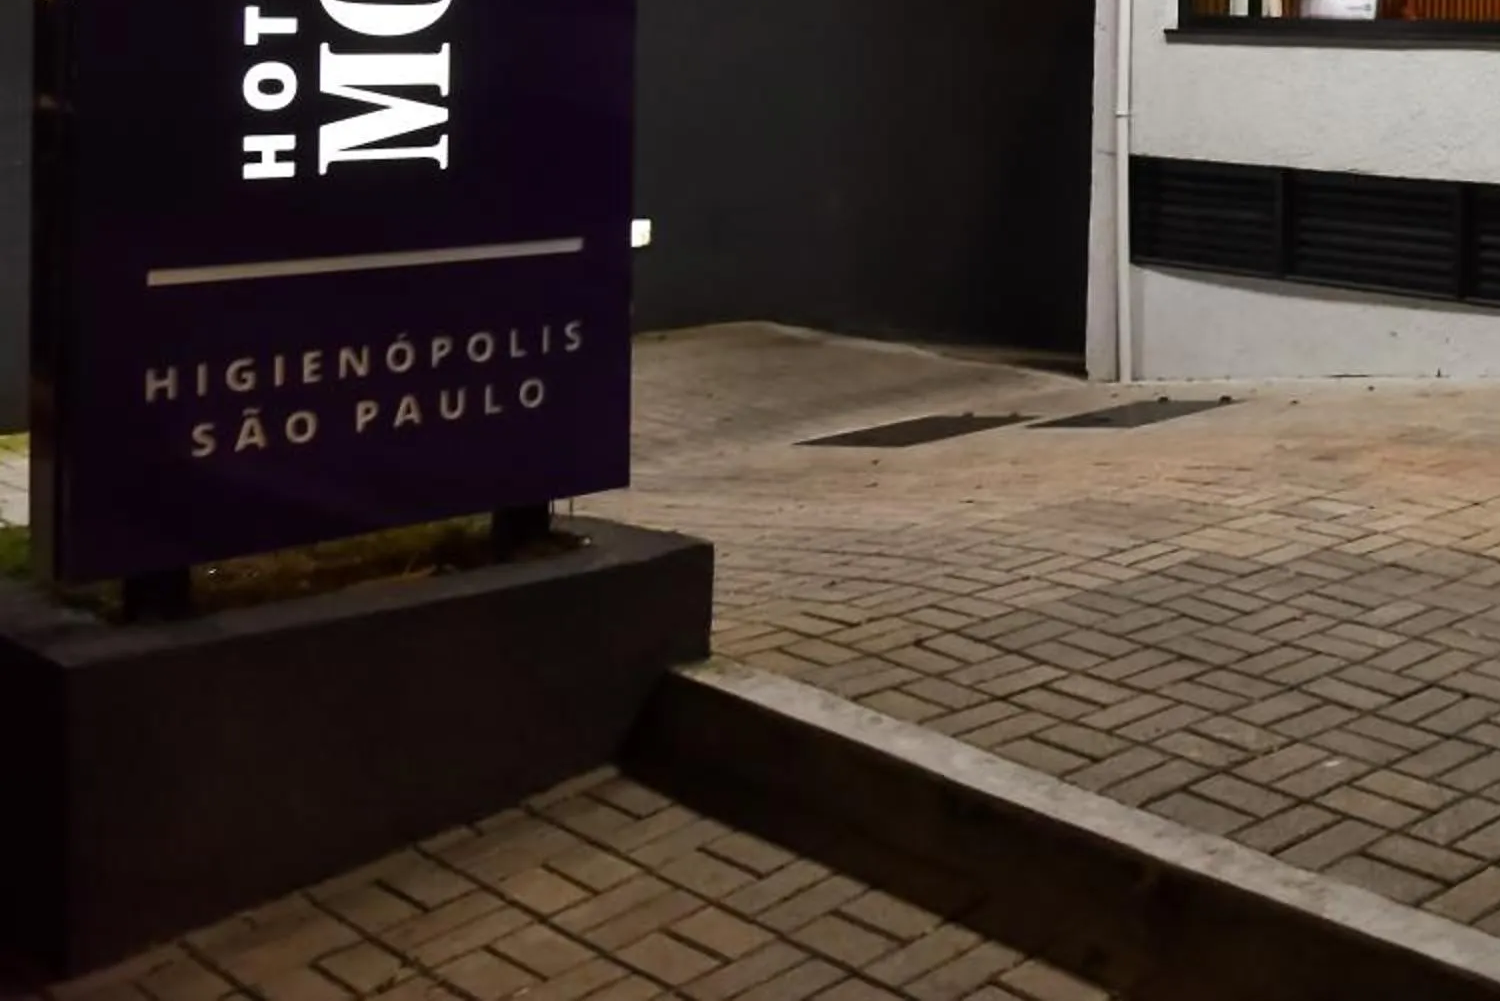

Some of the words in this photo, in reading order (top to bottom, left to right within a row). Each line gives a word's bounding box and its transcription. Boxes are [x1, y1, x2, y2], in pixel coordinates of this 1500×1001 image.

[145, 321, 584, 403] HIGIENÓPOLIS
[190, 407, 318, 458] SÃO
[355, 377, 545, 433] PAULO
